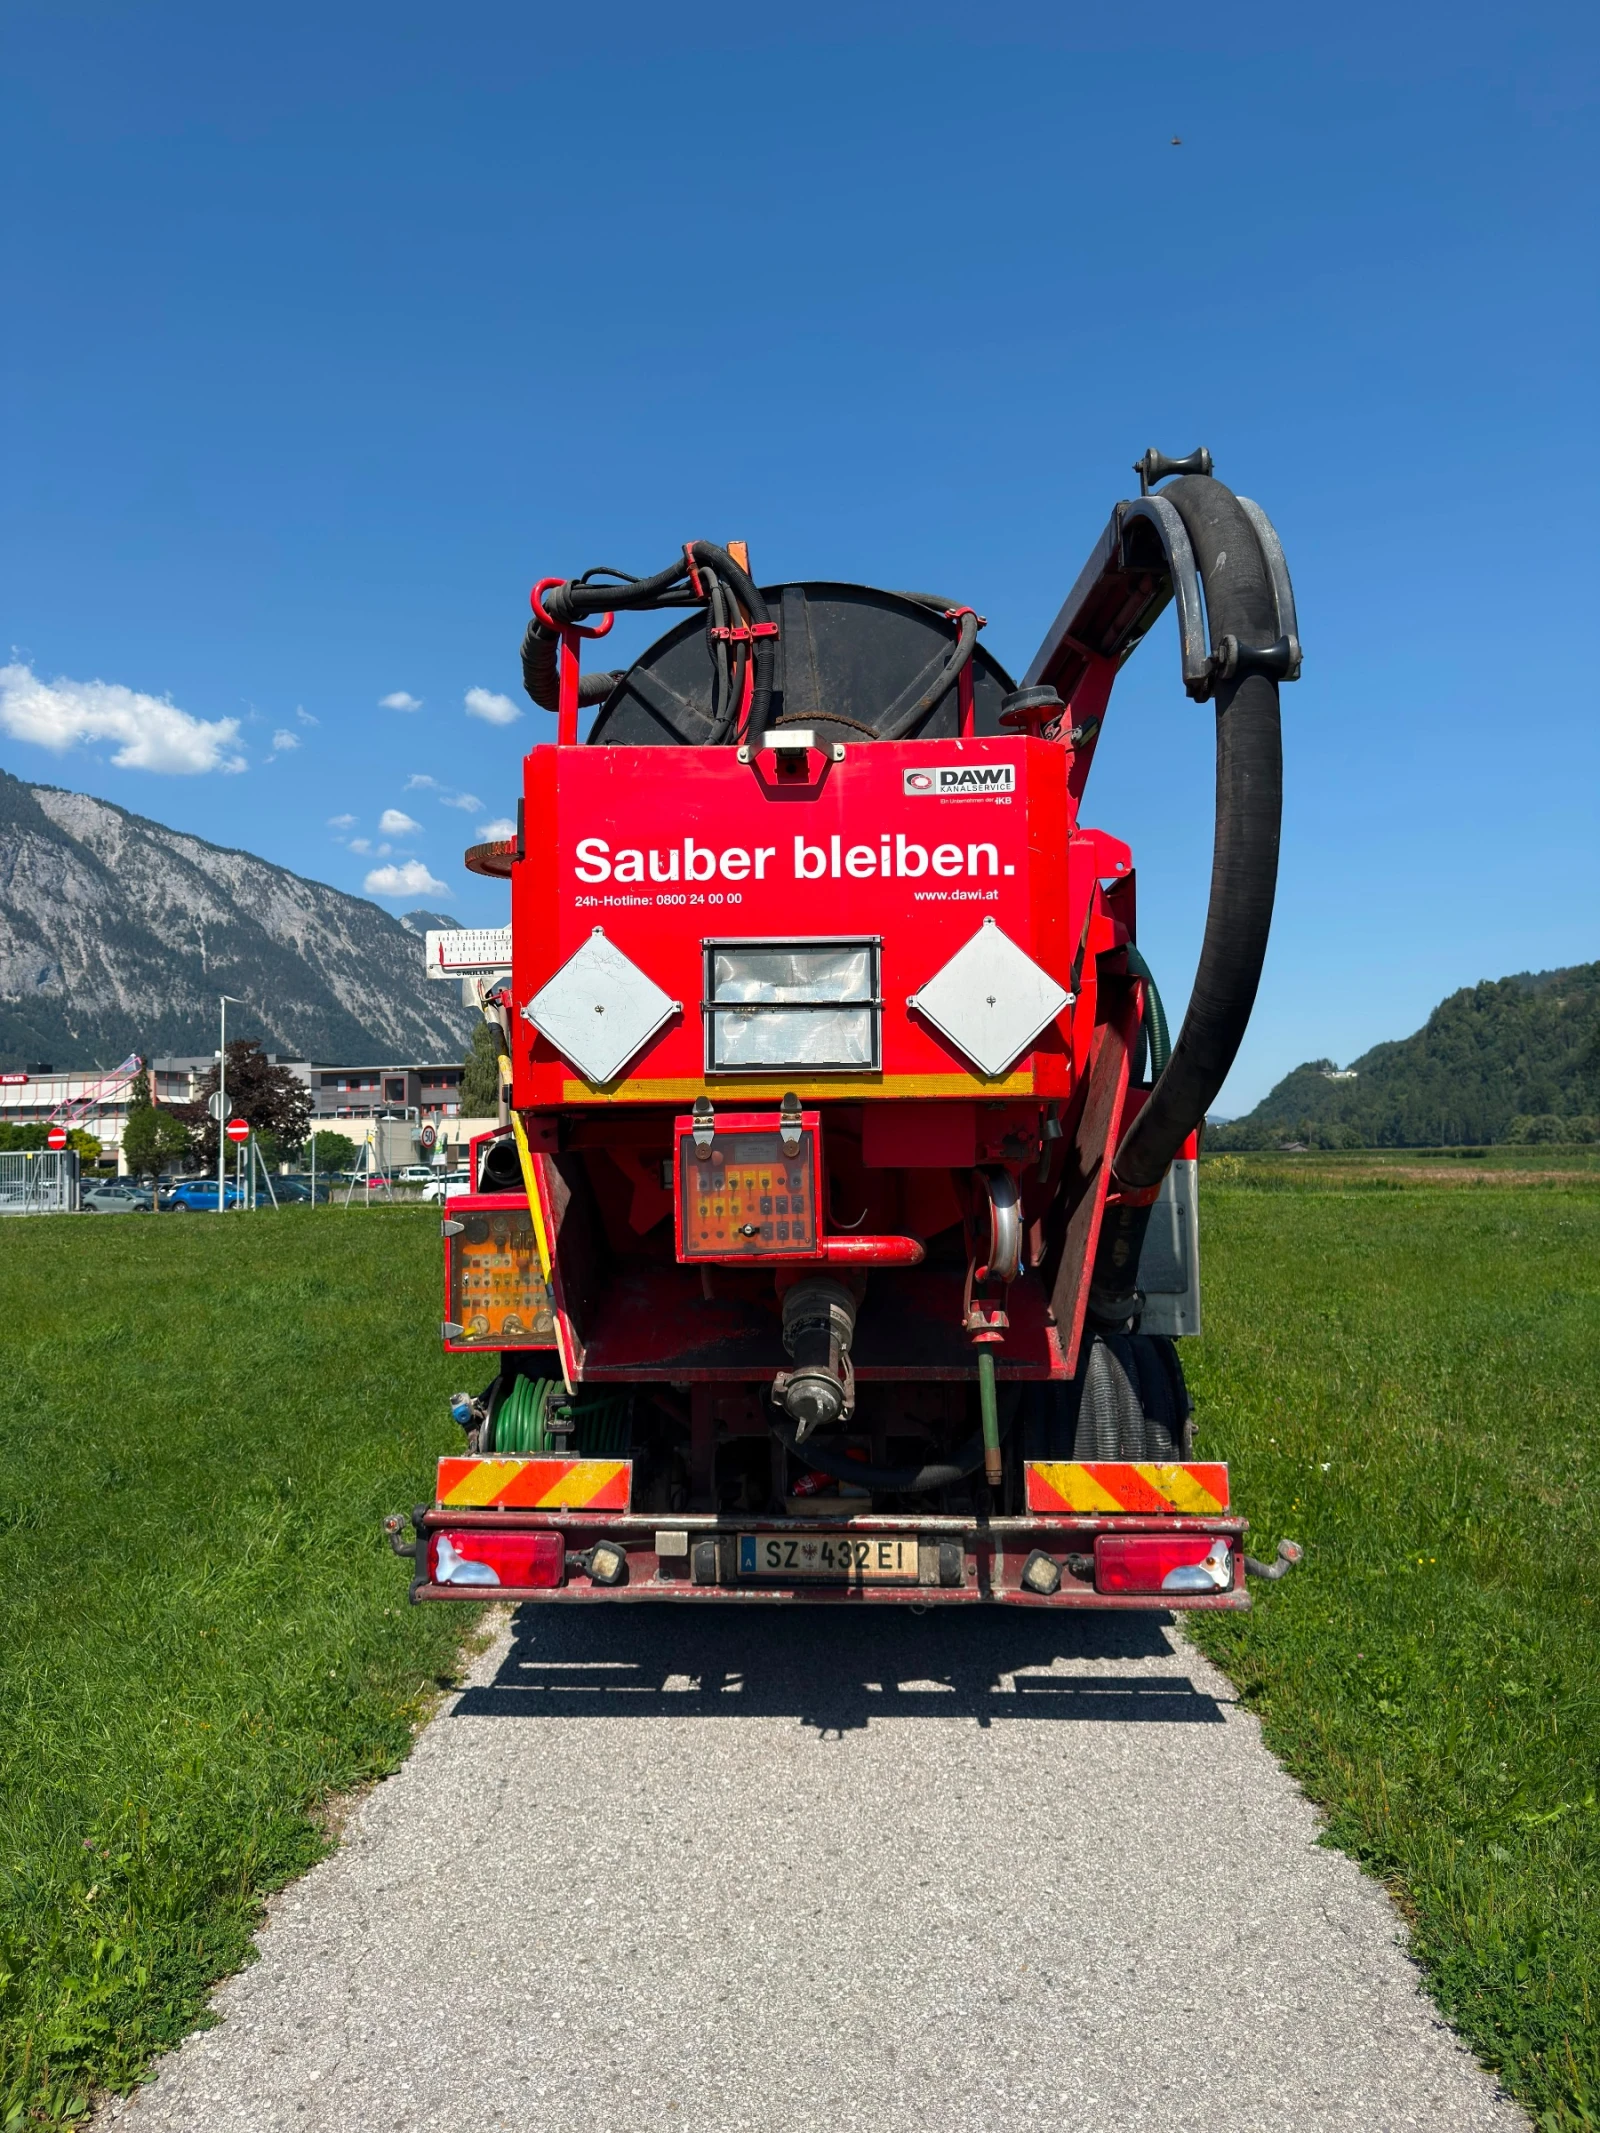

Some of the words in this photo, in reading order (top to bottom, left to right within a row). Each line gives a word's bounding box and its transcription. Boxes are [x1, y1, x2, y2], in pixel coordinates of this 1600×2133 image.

[940, 769, 1011, 785] DAWI
[940, 783, 1011, 792] KANALSERVICE
[574, 838, 775, 883] Sauber
[794, 834, 1016, 879] bleiben.
[574, 895, 653, 907] 24h-Hotline:
[655, 894, 687, 905] 0800
[689, 894, 705, 904] 24
[707, 893, 724, 904] 00
[726, 893, 743, 904] 00
[914, 889, 999, 901] www.dawi.at
[425, 1130, 433, 1142] 50
[766, 1541, 799, 1568] SZ
[820, 1541, 870, 1569] 432
[878, 1542, 903, 1569] EI
[745, 1558, 752, 1567] A
